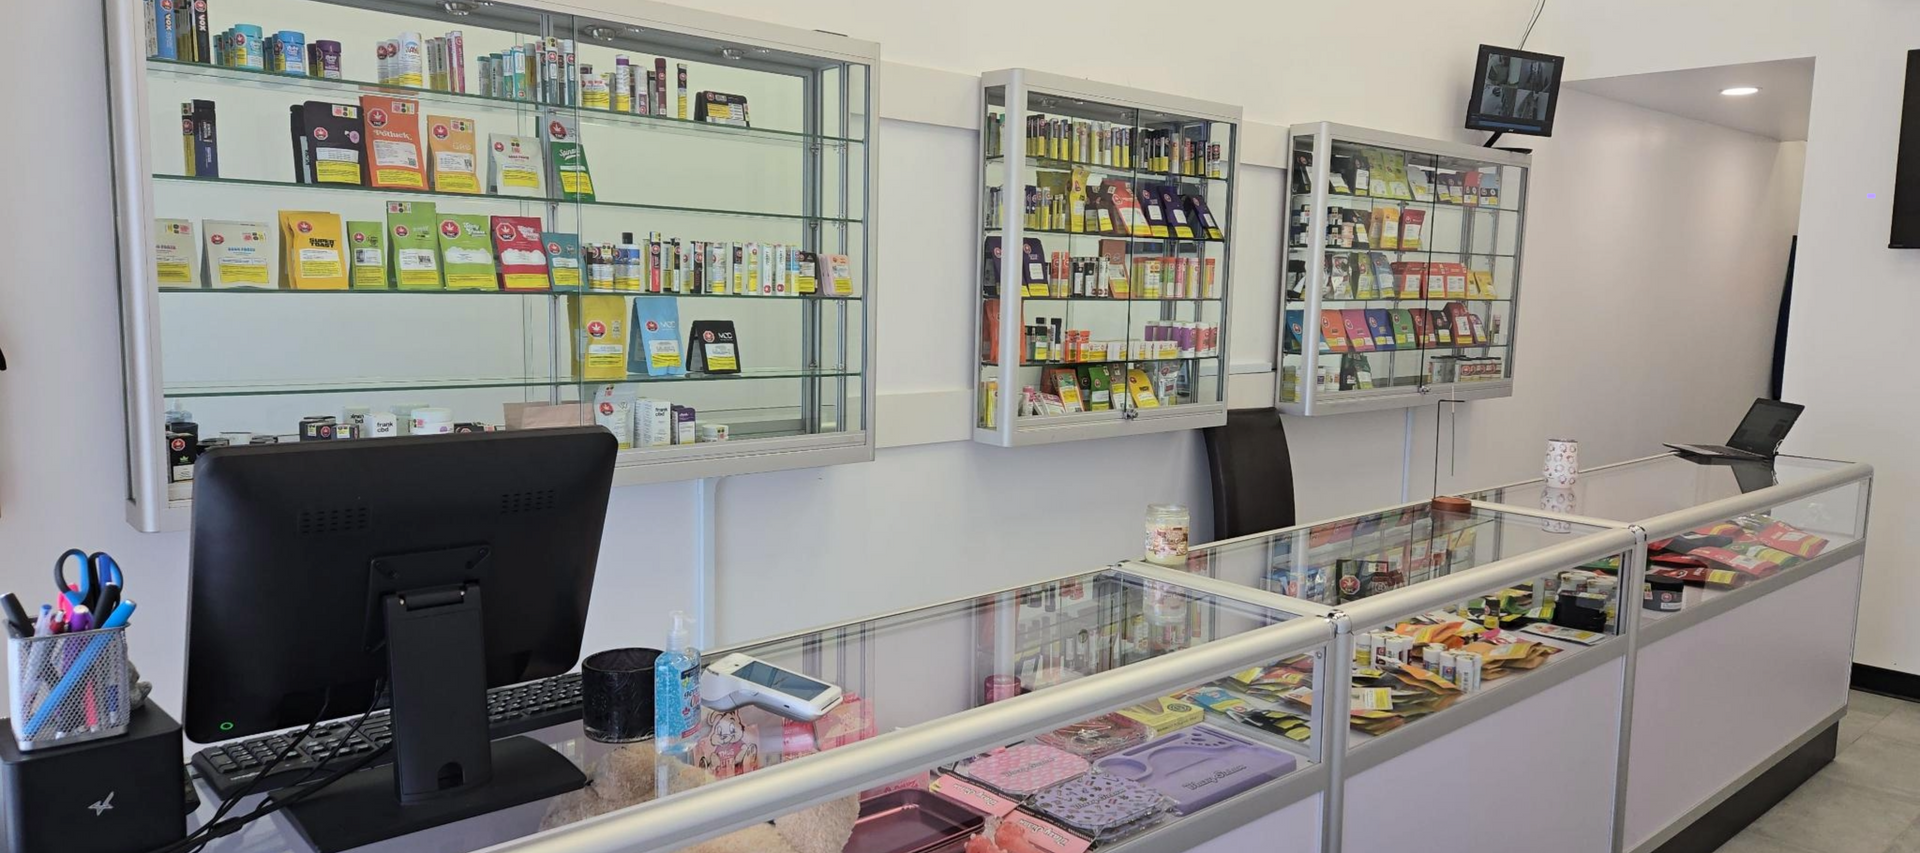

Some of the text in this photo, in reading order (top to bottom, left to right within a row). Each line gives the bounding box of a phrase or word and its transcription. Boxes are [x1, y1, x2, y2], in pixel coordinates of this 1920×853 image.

[164, 13, 172, 31] VOX
[198, 14, 207, 32] VOX
[373, 129, 413, 141] Potluck
[309, 237, 336, 245] SUPER
[1019, 818, 1045, 833] Susan
[1044, 827, 1070, 847] Blazy
